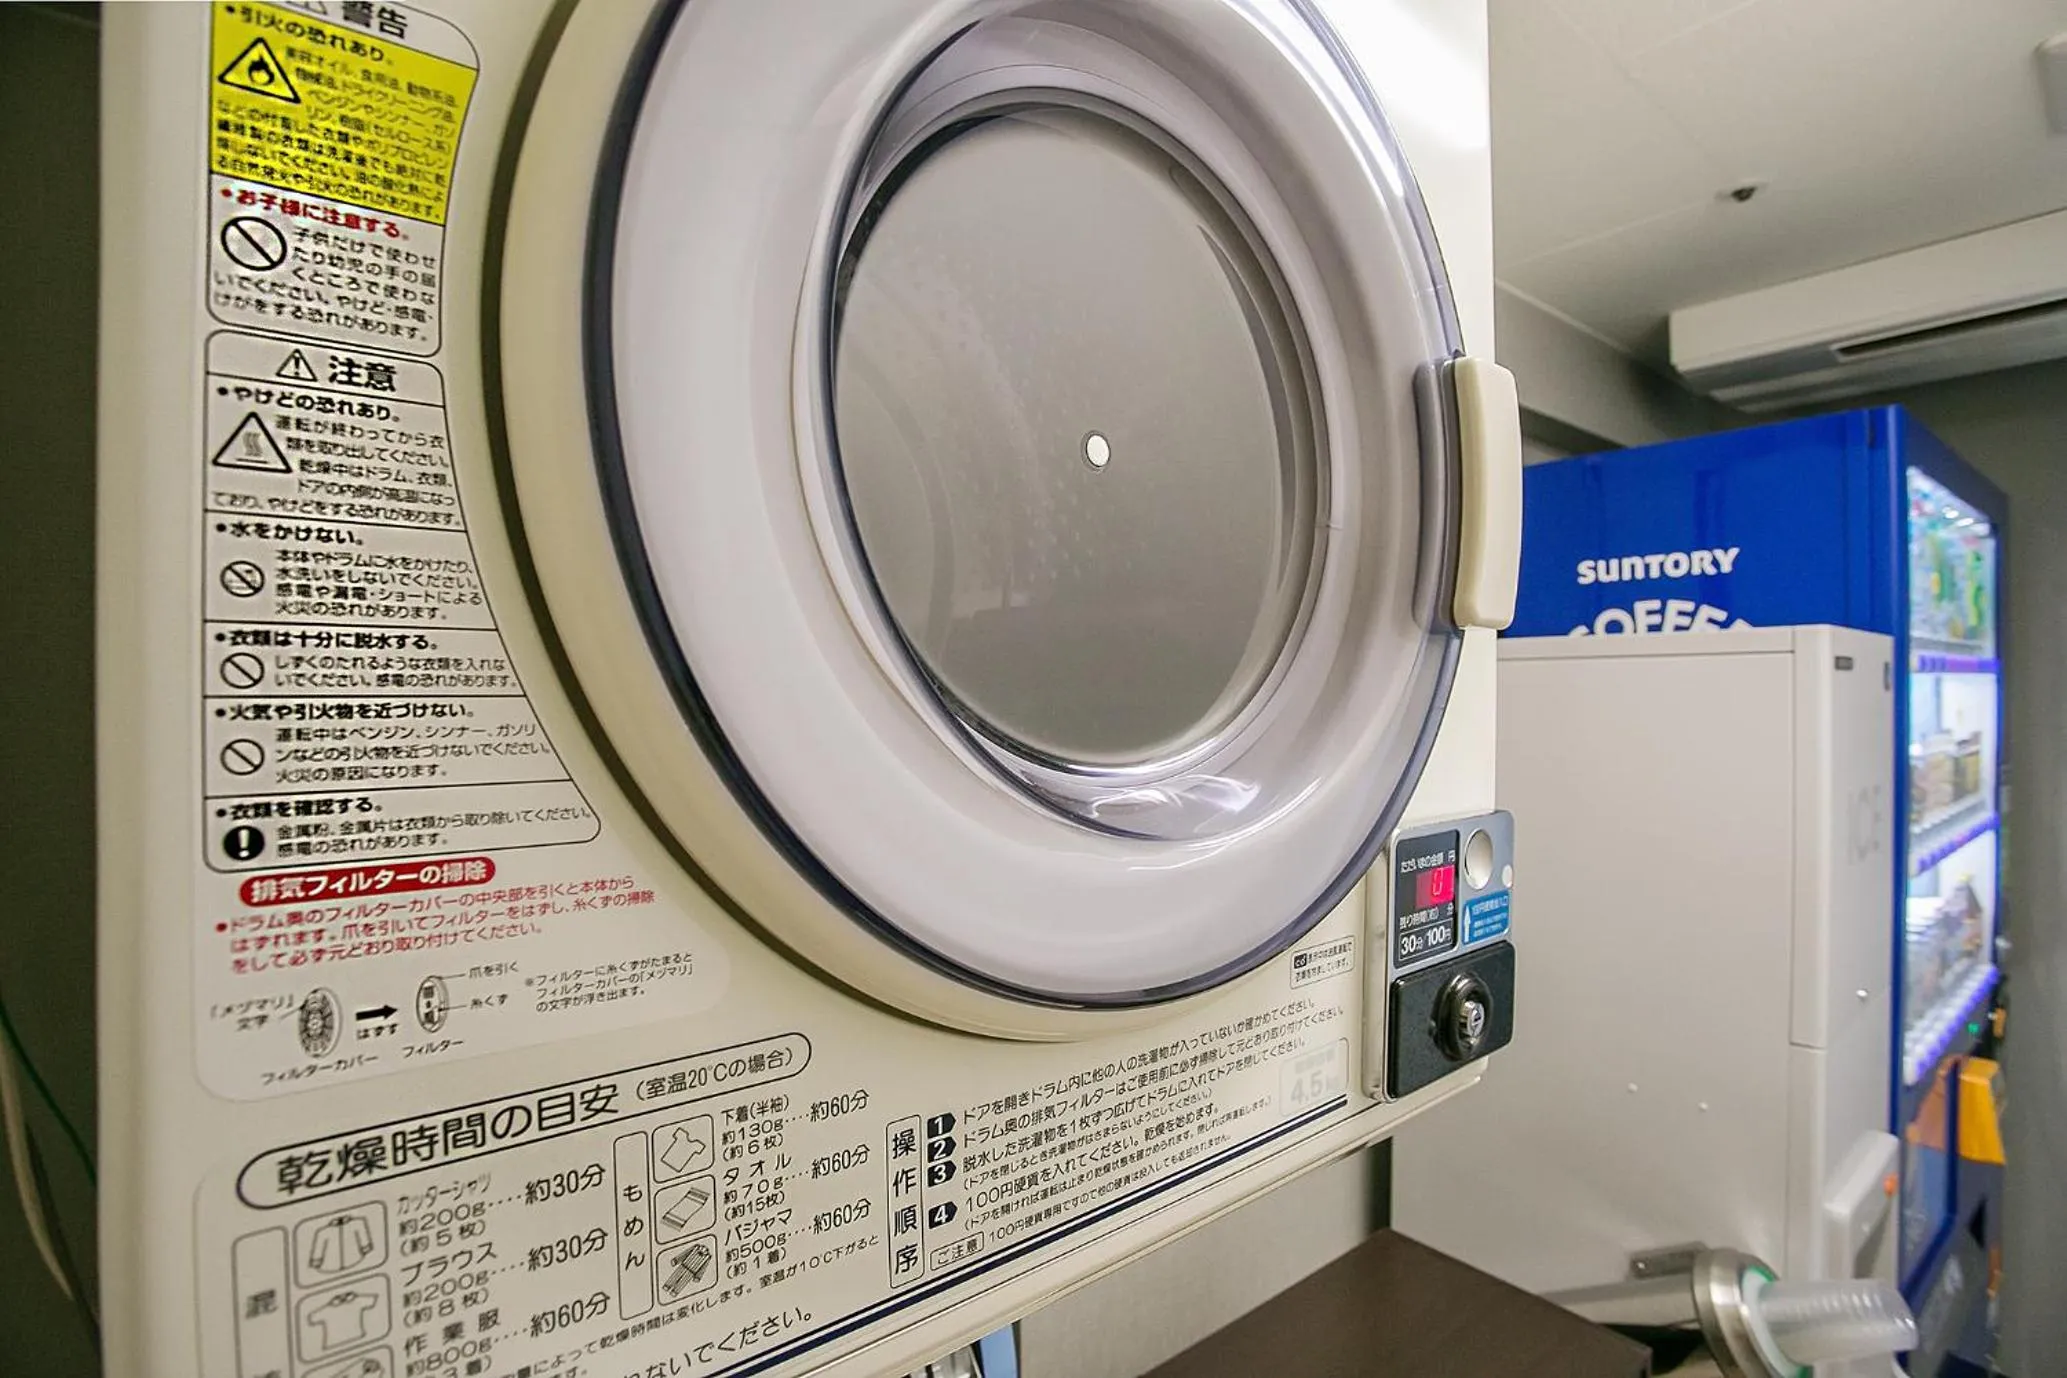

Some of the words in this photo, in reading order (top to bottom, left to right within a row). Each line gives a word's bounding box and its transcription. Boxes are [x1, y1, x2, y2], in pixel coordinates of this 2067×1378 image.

[240, 7, 393, 66] 引火の恐れあり。
[343, 0, 408, 39] 警告
[236, 188, 410, 241] お子様に注意する。
[294, 227, 436, 269] 子供だけで使わせ
[293, 267, 435, 305] くところで使わな
[328, 355, 397, 392] 注意
[234, 386, 400, 423] やけどの恐れあり。
[230, 520, 363, 546] 水をかけない。
[275, 602, 447, 620] 火災の恐れがあります。
[228, 629, 438, 651] 衣類は十分に脱水する。
[230, 702, 474, 724] 火気や引火物を近づけない。
[275, 765, 448, 785] 火災の原因になります。
[229, 797, 383, 821] 衣類を確認する。
[277, 832, 448, 858] 感電の恐れがあります。
[250, 859, 487, 901] 排気フィルターの掃除
[402, 1039, 464, 1059] フィルター
[260, 1055, 379, 1087] フィルターカバー
[810, 1089, 870, 1122] 約60分
[276, 1081, 620, 1195] 乾燥時間の目安
[811, 1144, 870, 1178] 約60分
[525, 1163, 607, 1205] 約30分
[892, 1128, 918, 1275] 操作順序
[622, 1184, 646, 1271] もめん
[813, 1198, 871, 1233] 約60分
[528, 1227, 608, 1272] 約30分
[530, 1291, 610, 1337] 約60分
